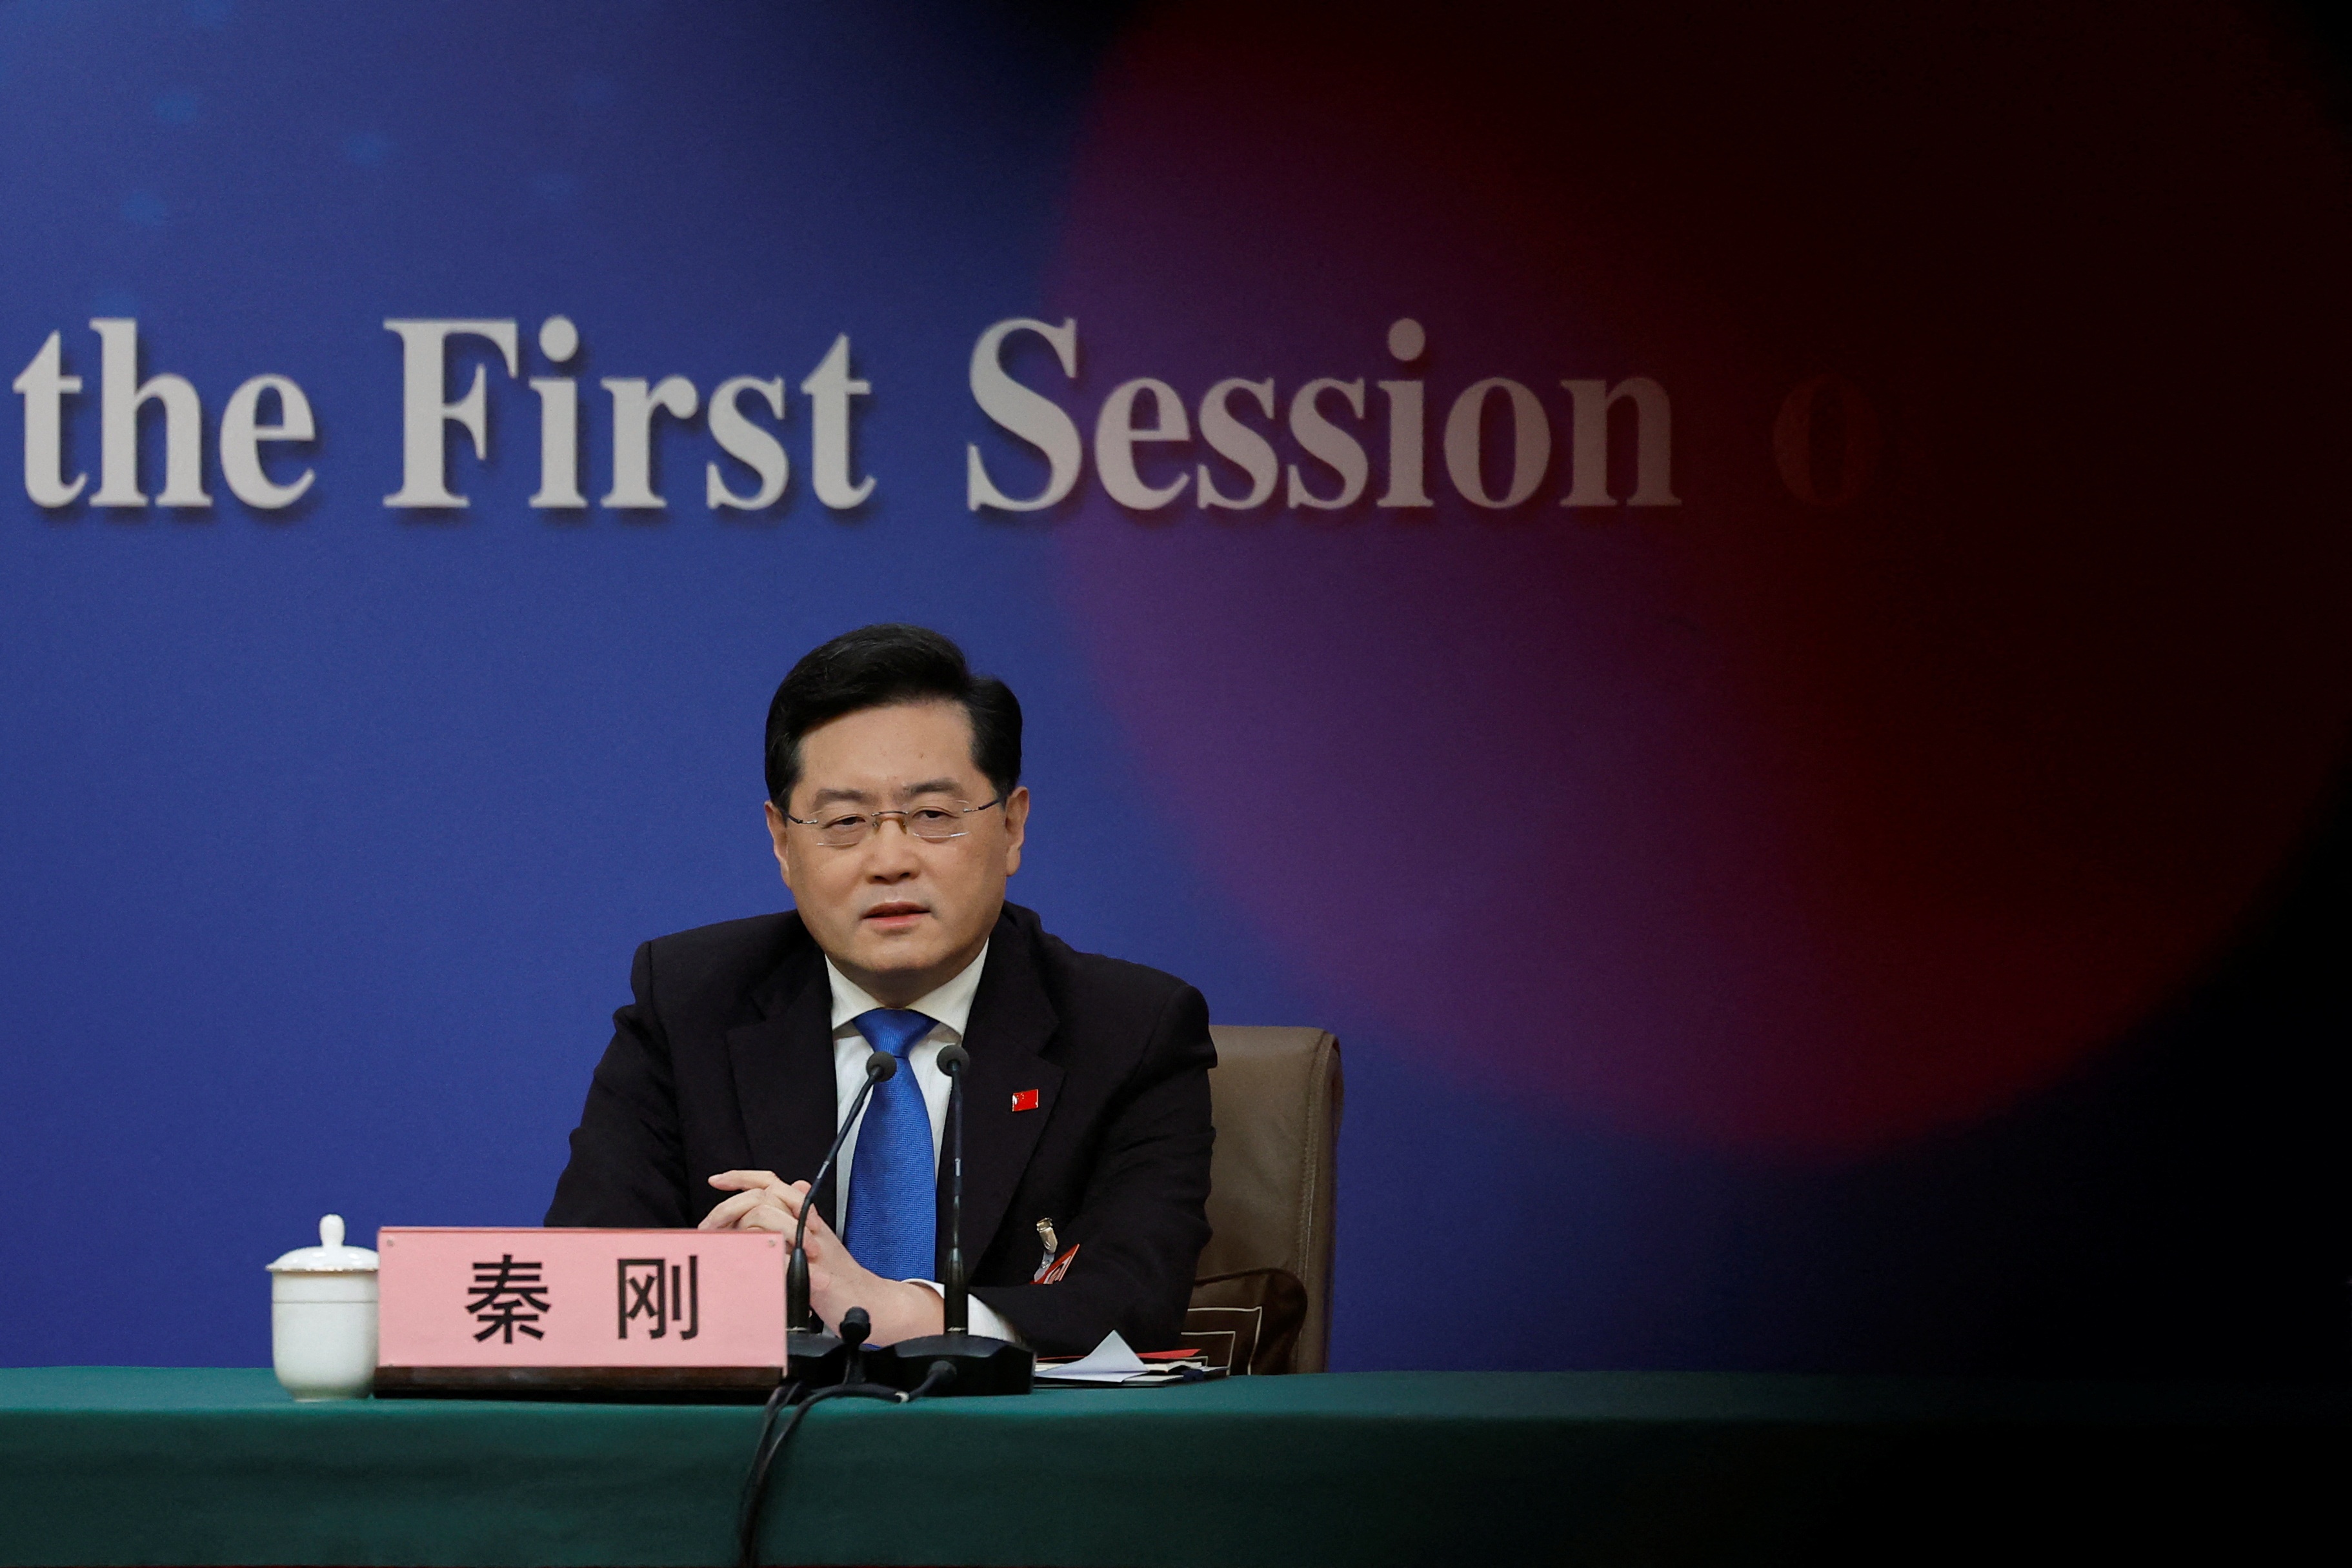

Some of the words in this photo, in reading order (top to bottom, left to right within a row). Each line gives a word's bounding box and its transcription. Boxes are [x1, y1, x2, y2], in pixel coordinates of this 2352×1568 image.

[12, 318, 316, 509] the
[383, 316, 876, 509] First
[966, 317, 1682, 511] Session
